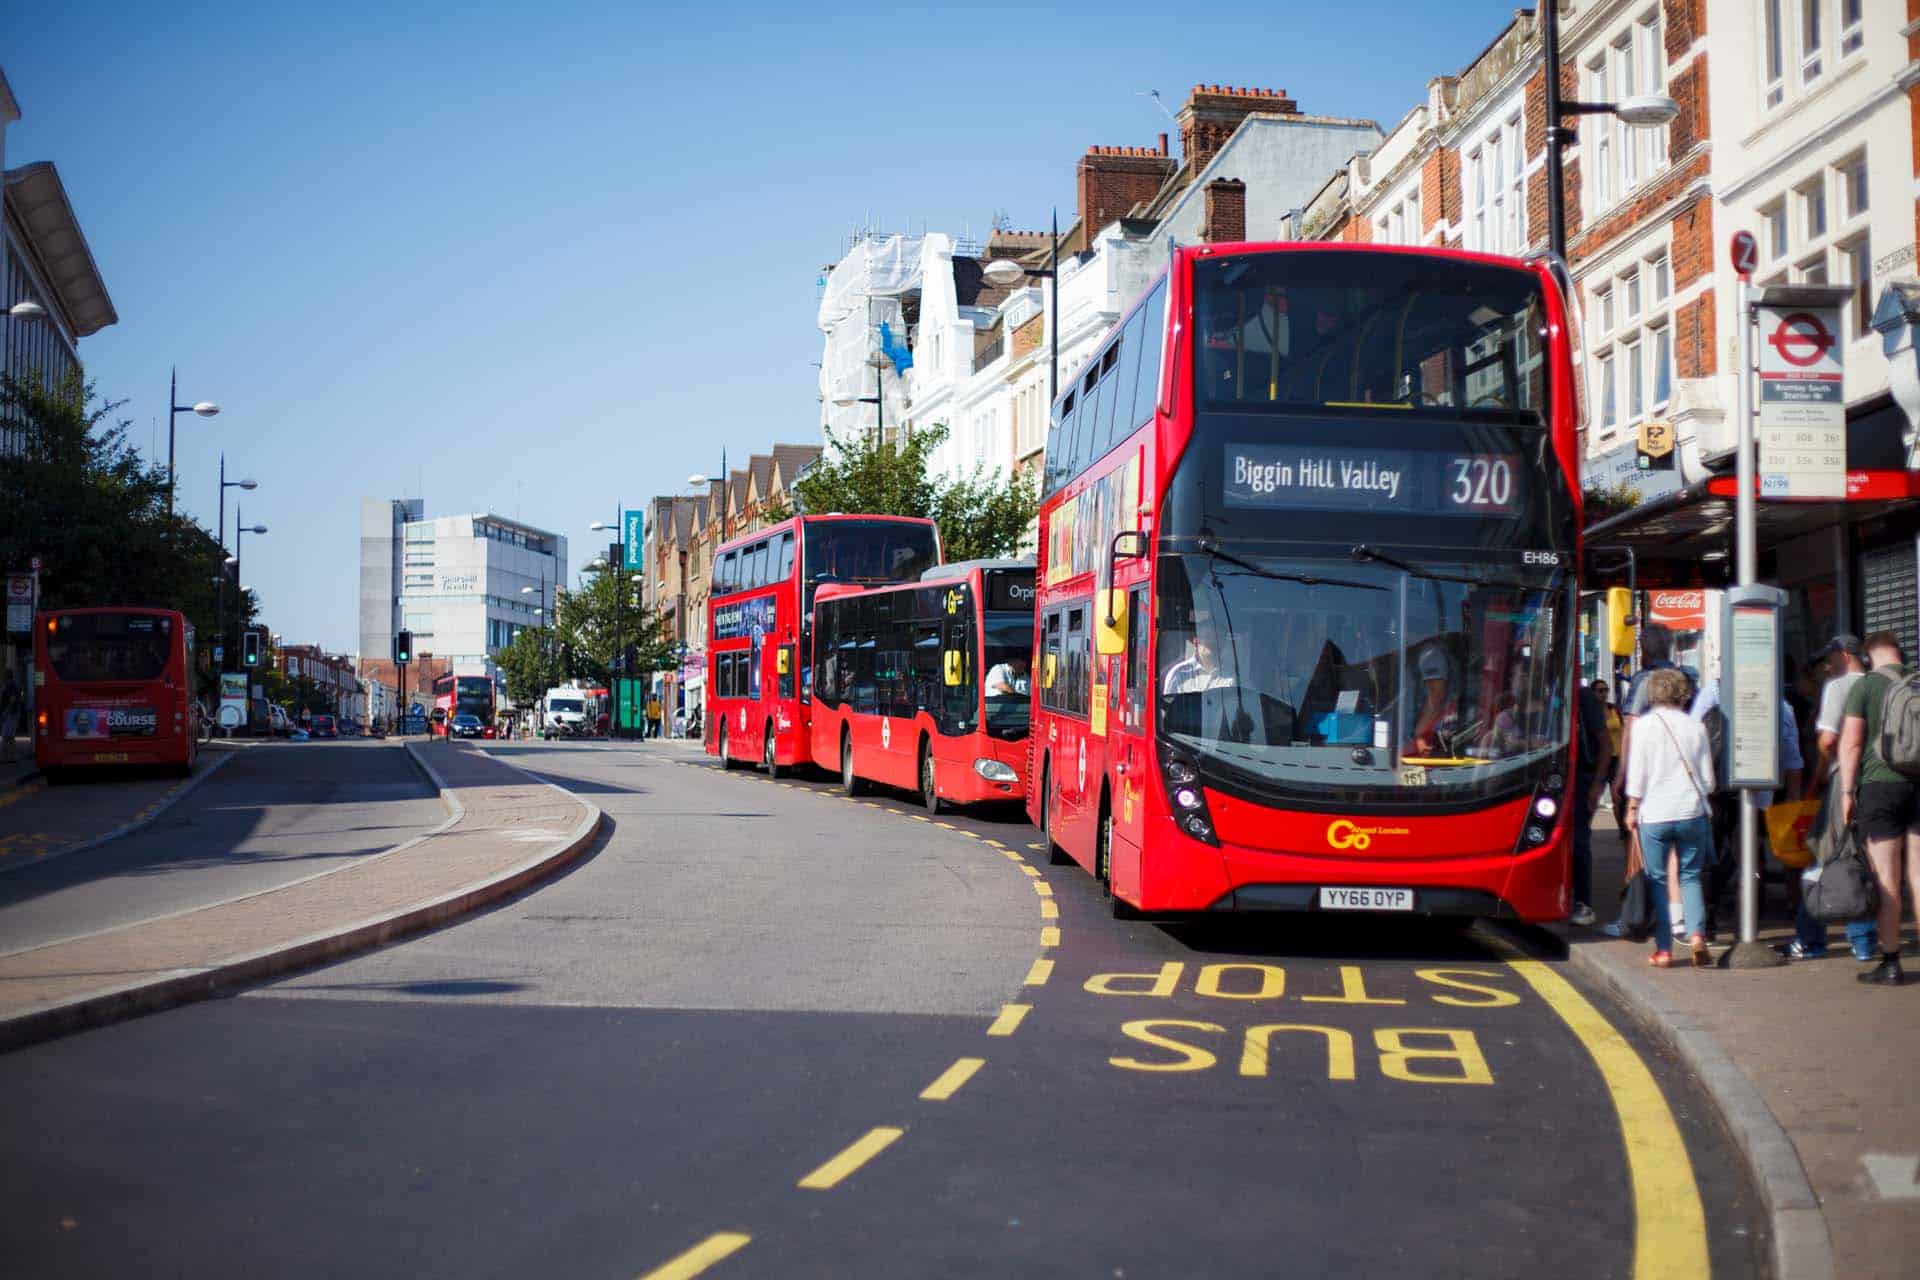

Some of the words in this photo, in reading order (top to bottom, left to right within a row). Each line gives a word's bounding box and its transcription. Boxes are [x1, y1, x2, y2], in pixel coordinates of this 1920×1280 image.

[1738, 236, 1754, 271] Z
[1235, 456, 1292, 493] Biggin
[1299, 458, 1334, 488] Hill
[1341, 461, 1400, 498] Valley
[1452, 459, 1511, 504] 320
[1524, 551, 1559, 565] EH86
[106, 713, 157, 726] COURSE
[1327, 819, 1371, 850] Go
[1328, 890, 1370, 906] YY66
[1375, 891, 1405, 907] OYP
[1083, 962, 1521, 1007] STOP
[1108, 1019, 1495, 1084] BUS
